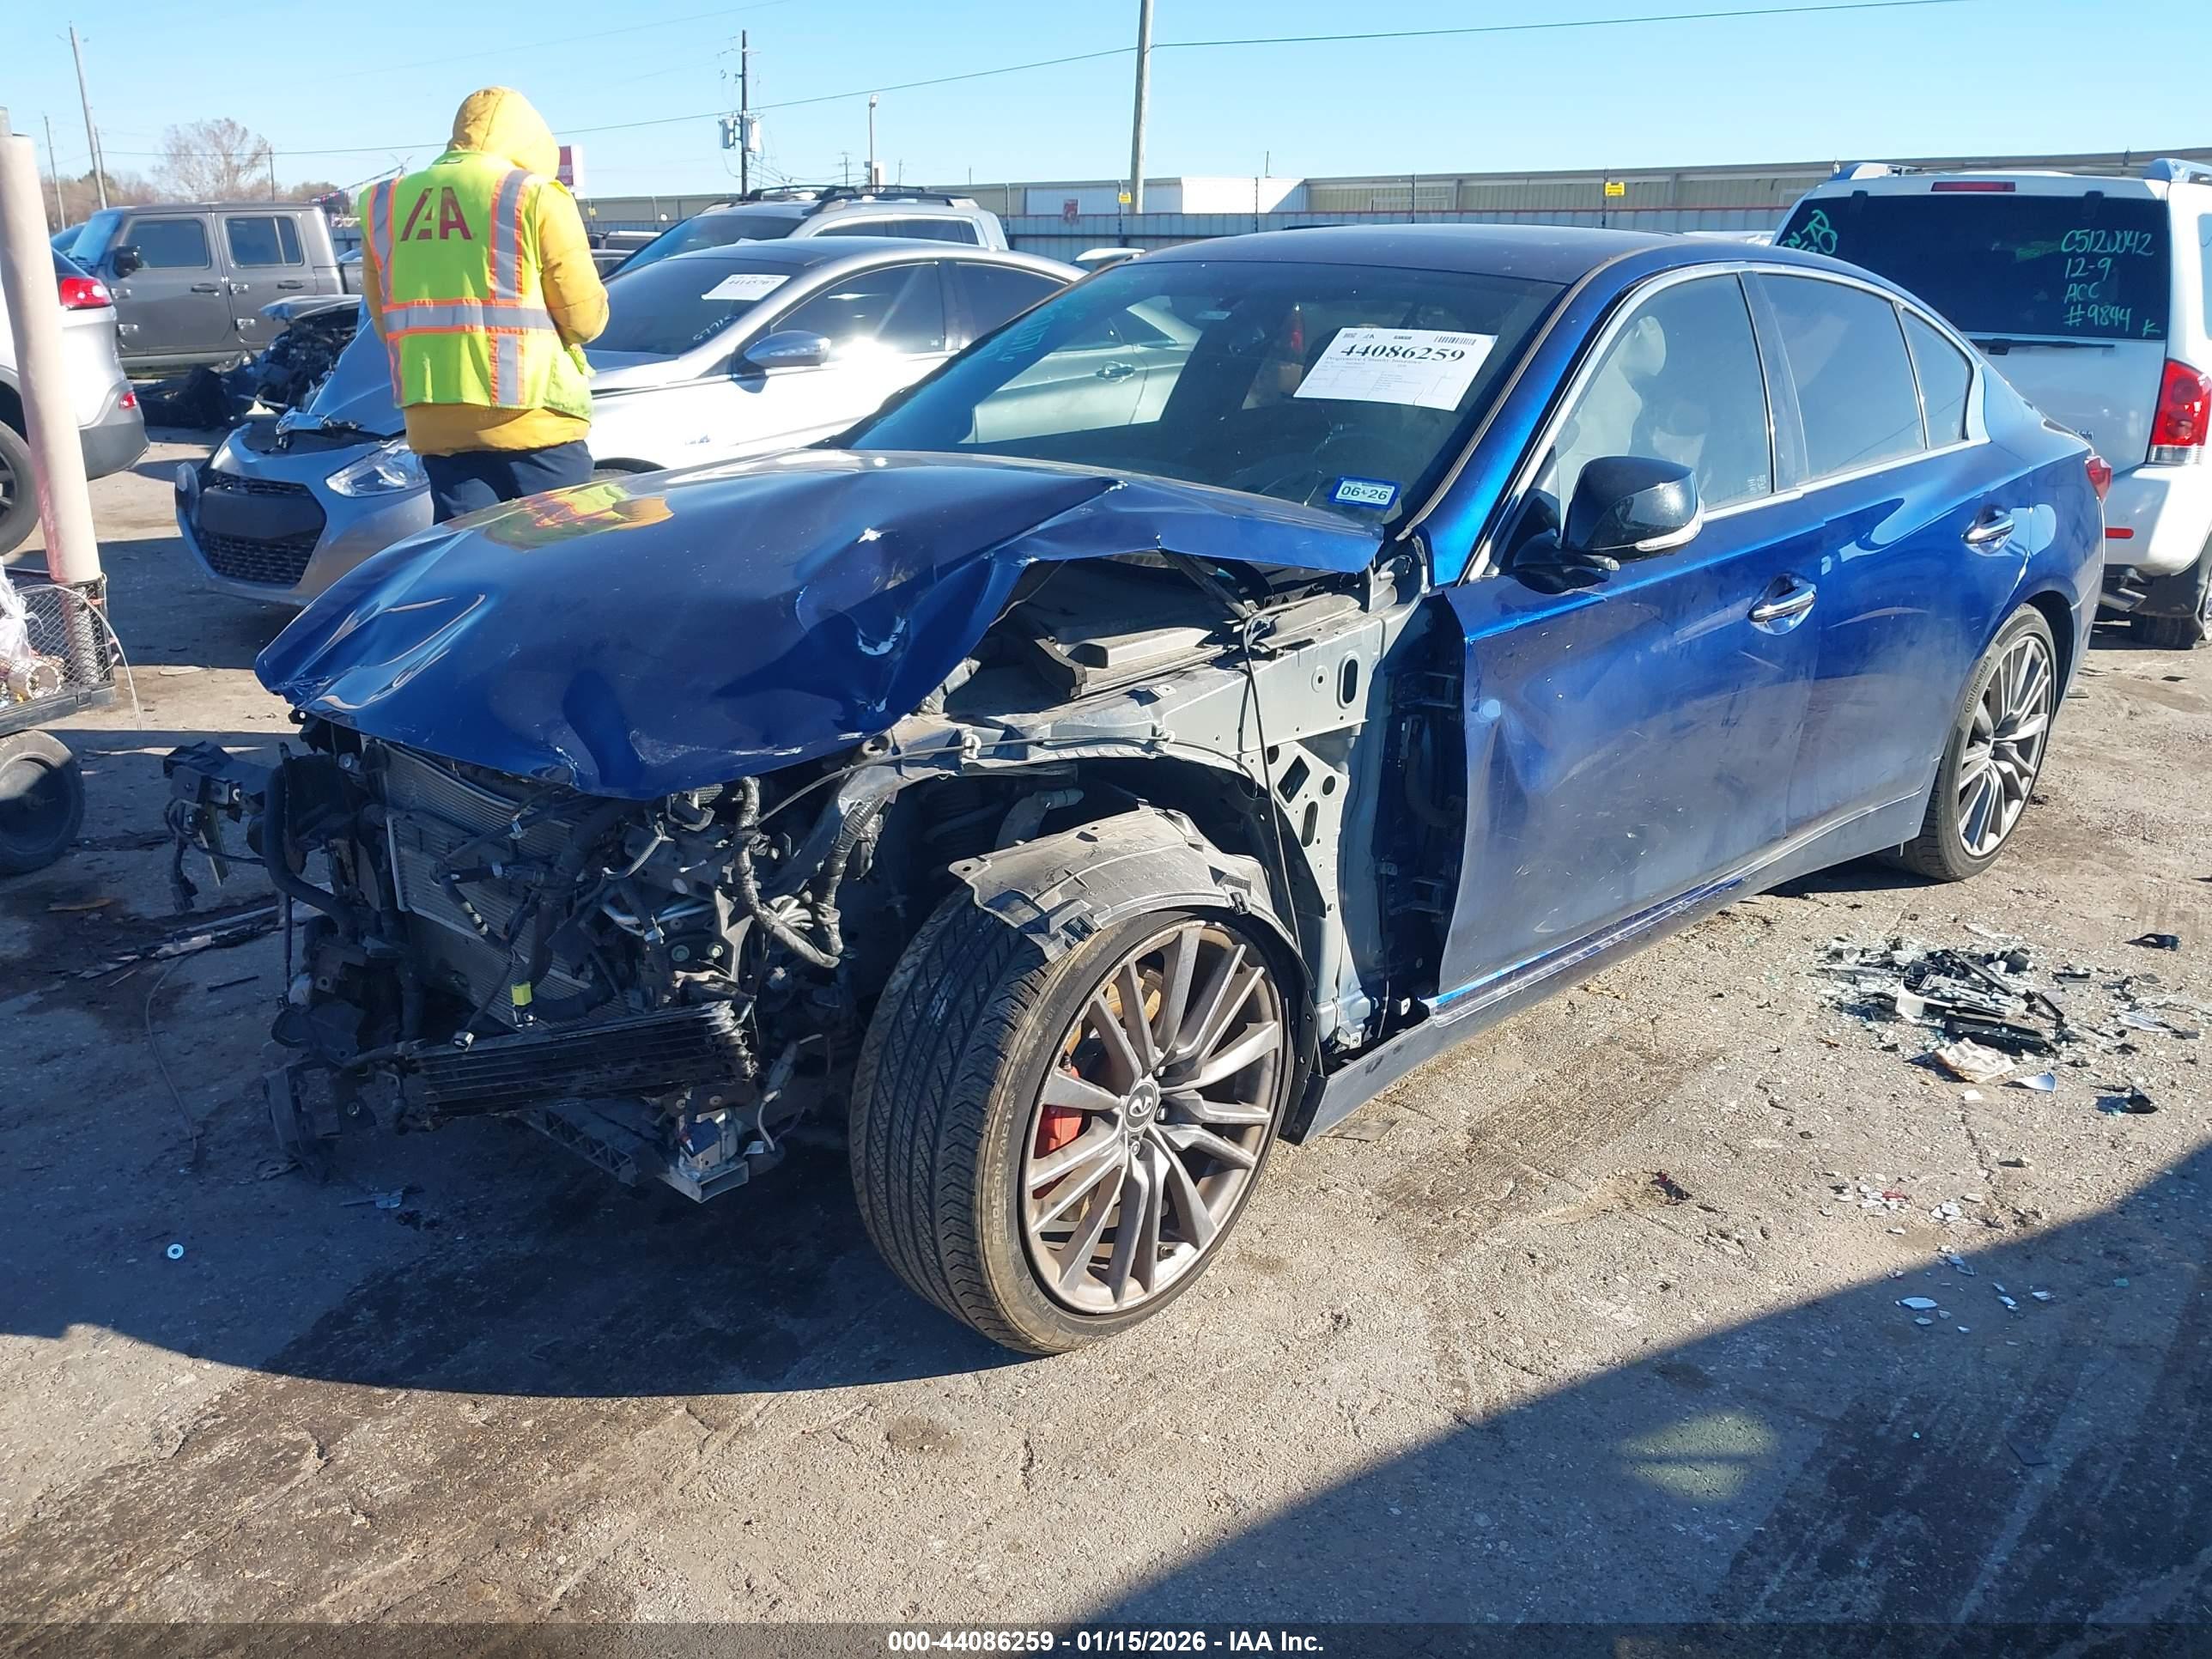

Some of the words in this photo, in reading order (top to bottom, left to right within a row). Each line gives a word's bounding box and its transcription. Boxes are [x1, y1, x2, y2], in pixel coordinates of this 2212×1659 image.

[2064, 257, 2112, 282] 12-9
[2063, 281, 2100, 304] ACC
[2063, 304, 2132, 332] #9844
[1340, 343, 1466, 362] 44086259
[1341, 486, 1362, 496] 06
[1367, 489, 1389, 500] 26
